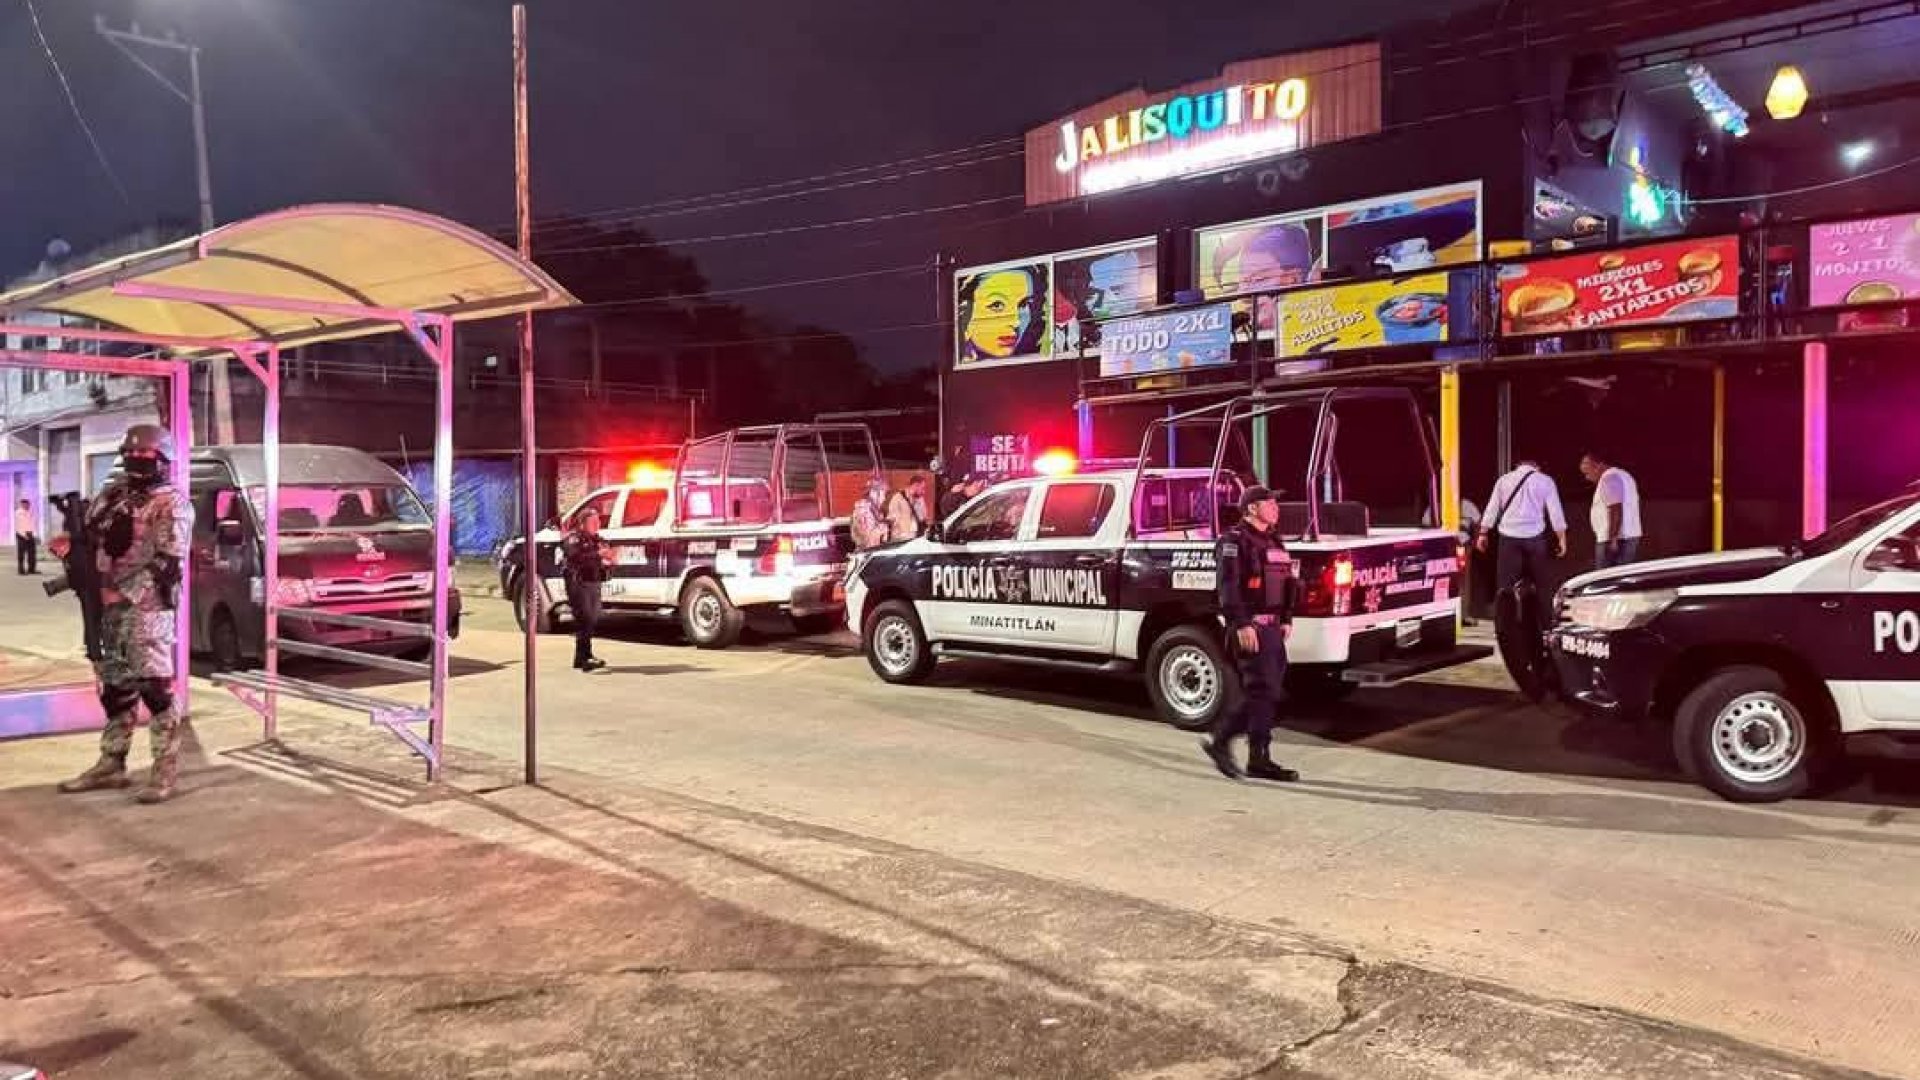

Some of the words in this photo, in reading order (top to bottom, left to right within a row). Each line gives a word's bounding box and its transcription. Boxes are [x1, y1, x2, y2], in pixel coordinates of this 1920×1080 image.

[1055, 78, 1308, 174] JALISQUITO
[1599, 276, 1654, 302] 2X1
[1107, 329, 1169, 354] TODO
[1174, 310, 1225, 333] 2X1
[991, 434, 1015, 454] SE
[931, 562, 999, 600] POLICÍA
[1029, 567, 1107, 605] MUNICIPAL
[970, 613, 1056, 632] MINATITLÁN
[1873, 610, 1920, 653] PO
